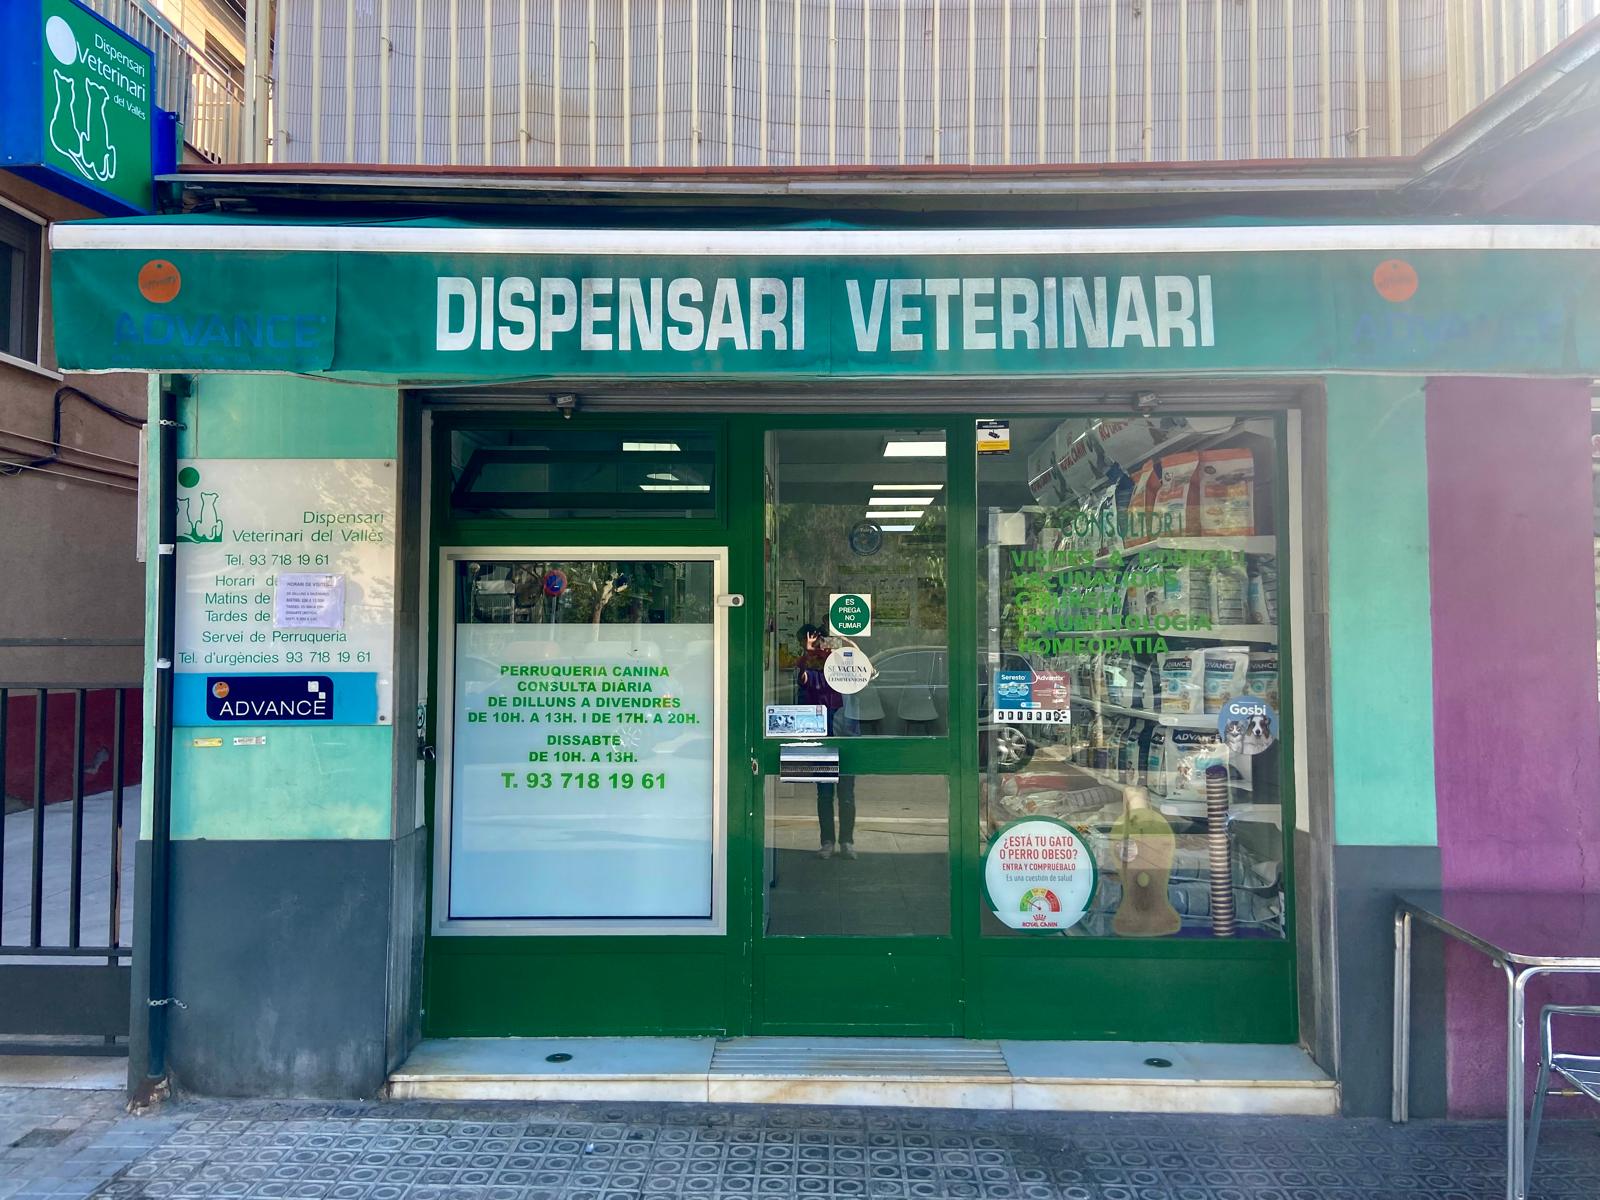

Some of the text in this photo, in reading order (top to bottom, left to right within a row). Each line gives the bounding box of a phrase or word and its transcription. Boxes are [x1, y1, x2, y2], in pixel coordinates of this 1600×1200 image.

[94, 33, 145, 78] Dispensari
[76, 41, 146, 102] Veterinari
[113, 94, 125, 108] del
[436, 275, 1215, 352] DISPENSARI VETERINARI
[112, 311, 320, 349] ADVANCE
[303, 511, 384, 526] Dispensari
[232, 529, 303, 543] Veterinari
[311, 529, 333, 542] del
[225, 554, 330, 566] Tel. 93 718 19 61
[215, 575, 255, 587] Horari
[205, 593, 271, 605] Matins de
[205, 611, 271, 622] Tardes de
[202, 631, 347, 645] Servei de Perruqueria
[178, 652, 198, 664] Tel.
[286, 652, 303, 663] 93
[310, 652, 331, 663] 718
[337, 651, 351, 663] 19
[357, 651, 371, 663] 61
[501, 665, 670, 678] PERRUQUERIA CANINA
[517, 681, 597, 692] CONSULTA
[219, 700, 326, 716] ADVANCE
[488, 697, 681, 708] DE DILLUNS A DIVENDRES
[1229, 704, 1266, 715] Gosbi
[468, 712, 700, 724] DE 10H. A 13H. I DE 17H. A 20H.
[547, 735, 621, 746] DISSABTE
[529, 752, 638, 763] DE 10H. A 13H.
[501, 773, 666, 789] T. 93 718 19 61
[1004, 834, 1073, 849] ¿ESTÁ TU GATO
[1000, 849, 1078, 859] O PERRO OBESO?
